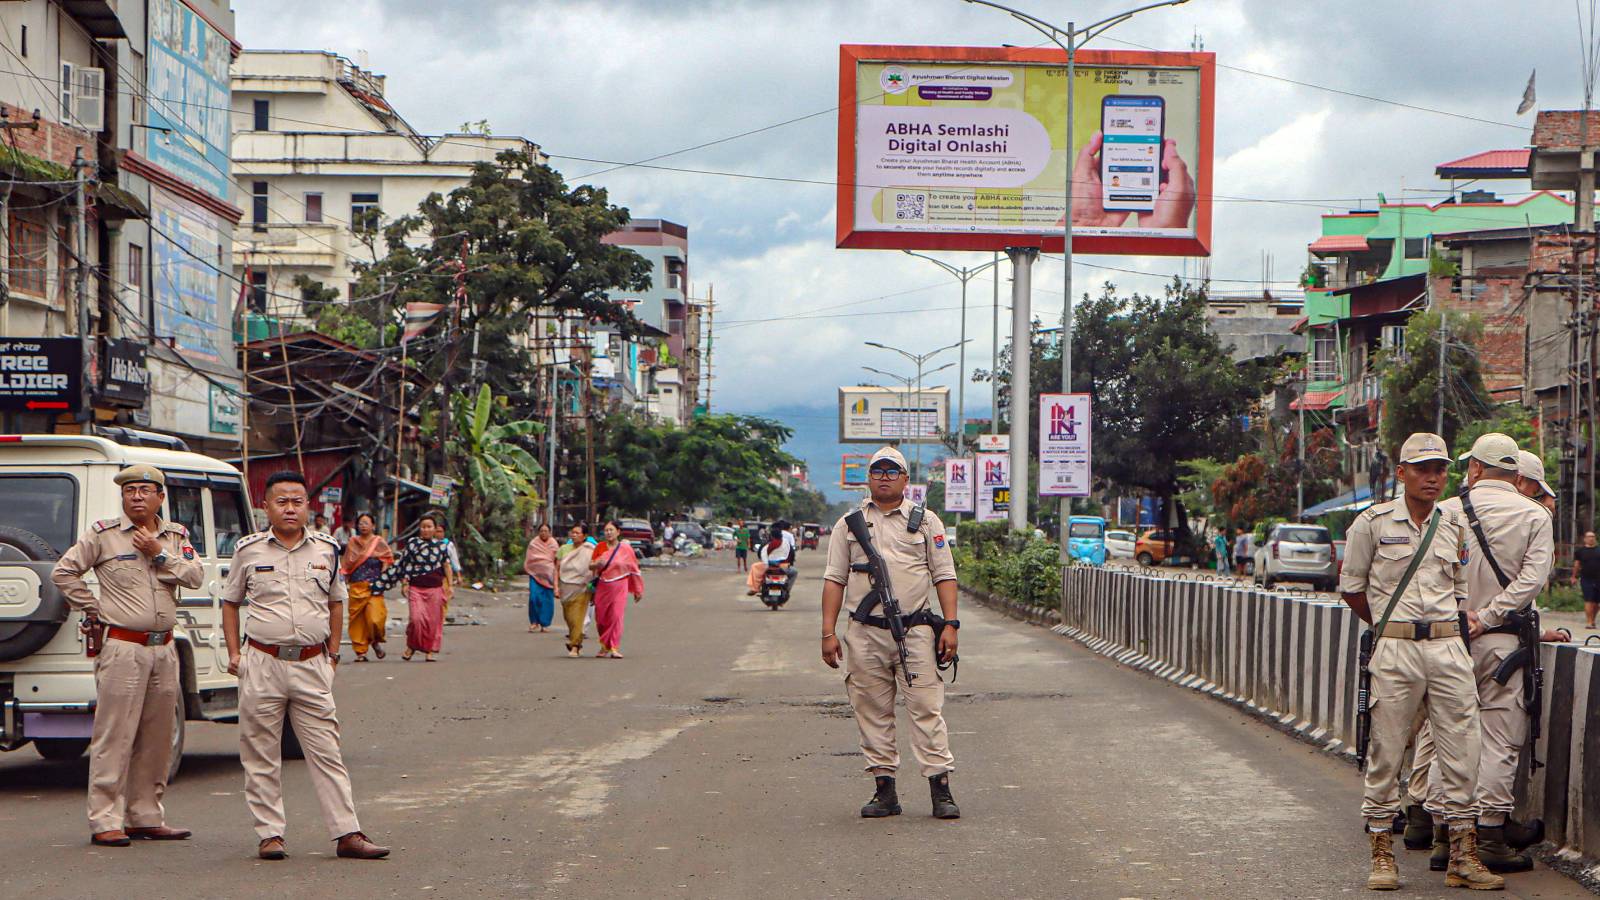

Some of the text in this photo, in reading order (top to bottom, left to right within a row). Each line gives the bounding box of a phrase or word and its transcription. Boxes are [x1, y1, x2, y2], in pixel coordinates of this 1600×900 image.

[886, 122, 1009, 137] ABHA Semlashi
[889, 139, 1007, 154] Digital Onlashi
